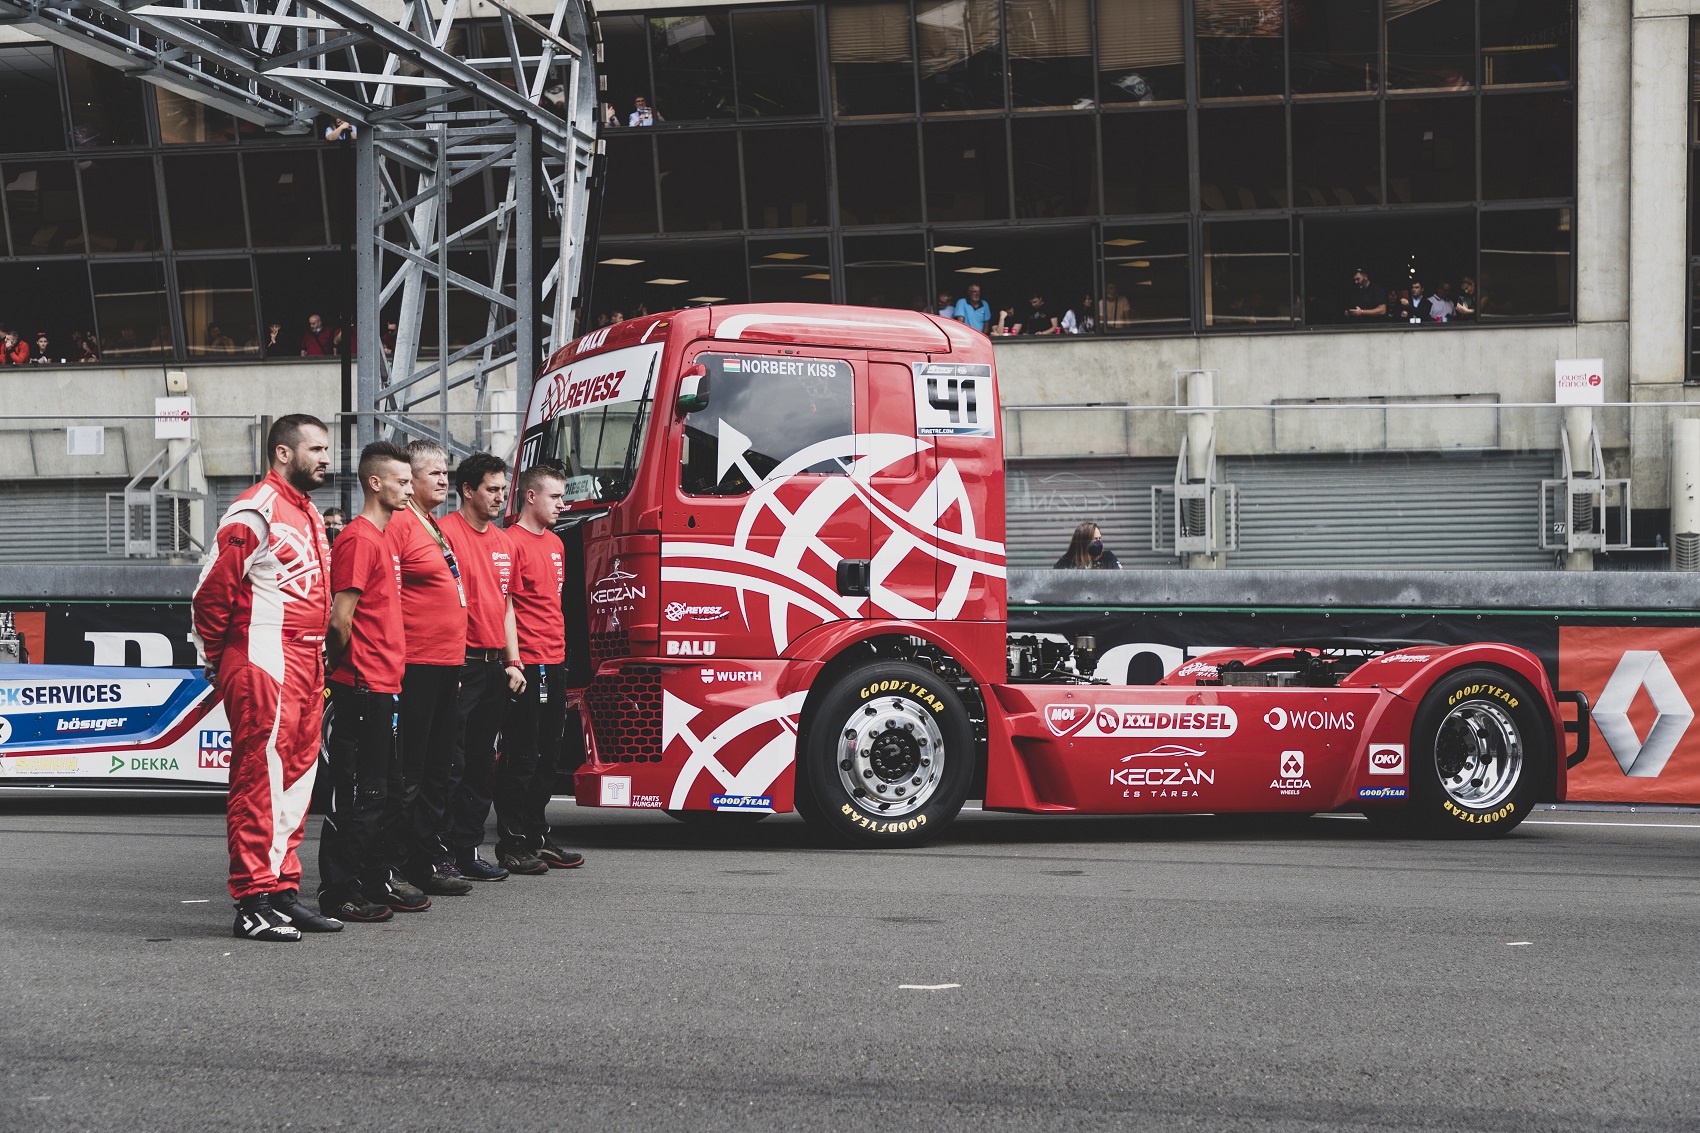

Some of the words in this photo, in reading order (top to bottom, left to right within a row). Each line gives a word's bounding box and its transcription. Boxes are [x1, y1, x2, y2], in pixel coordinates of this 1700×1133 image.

[575, 327, 612, 355] BALU
[741, 360, 804, 375] NORBERT
[807, 363, 836, 377] KISS
[564, 370, 626, 410] REVESZ
[1558, 380, 1588, 388] france
[927, 378, 977, 424] 41
[1554, 524, 1565, 533] 27
[686, 606, 722, 614] REVESZ
[666, 640, 716, 655] BALU
[860, 680, 945, 713] GOODYEAR
[1448, 684, 1519, 709] GOODYEAR
[1051, 708, 1076, 721] MOL
[1289, 711, 1355, 730] WOIMS
[56, 717, 127, 731] bösiger
[202, 731, 231, 748] LIQ
[15, 757, 78, 771] SCHUH
[131, 758, 179, 770] DEKRA
[1373, 754, 1400, 764] DKV
[1269, 779, 1312, 789] ALCOA
[1123, 789, 1141, 798] ÉS
[1151, 789, 1199, 798] TÁRSA
[1359, 787, 1406, 797] GOODYEAR
[712, 796, 770, 806] GOODYEAR
[841, 803, 927, 833] GOODYEAR
[1443, 800, 1515, 824] GOODYEAR
